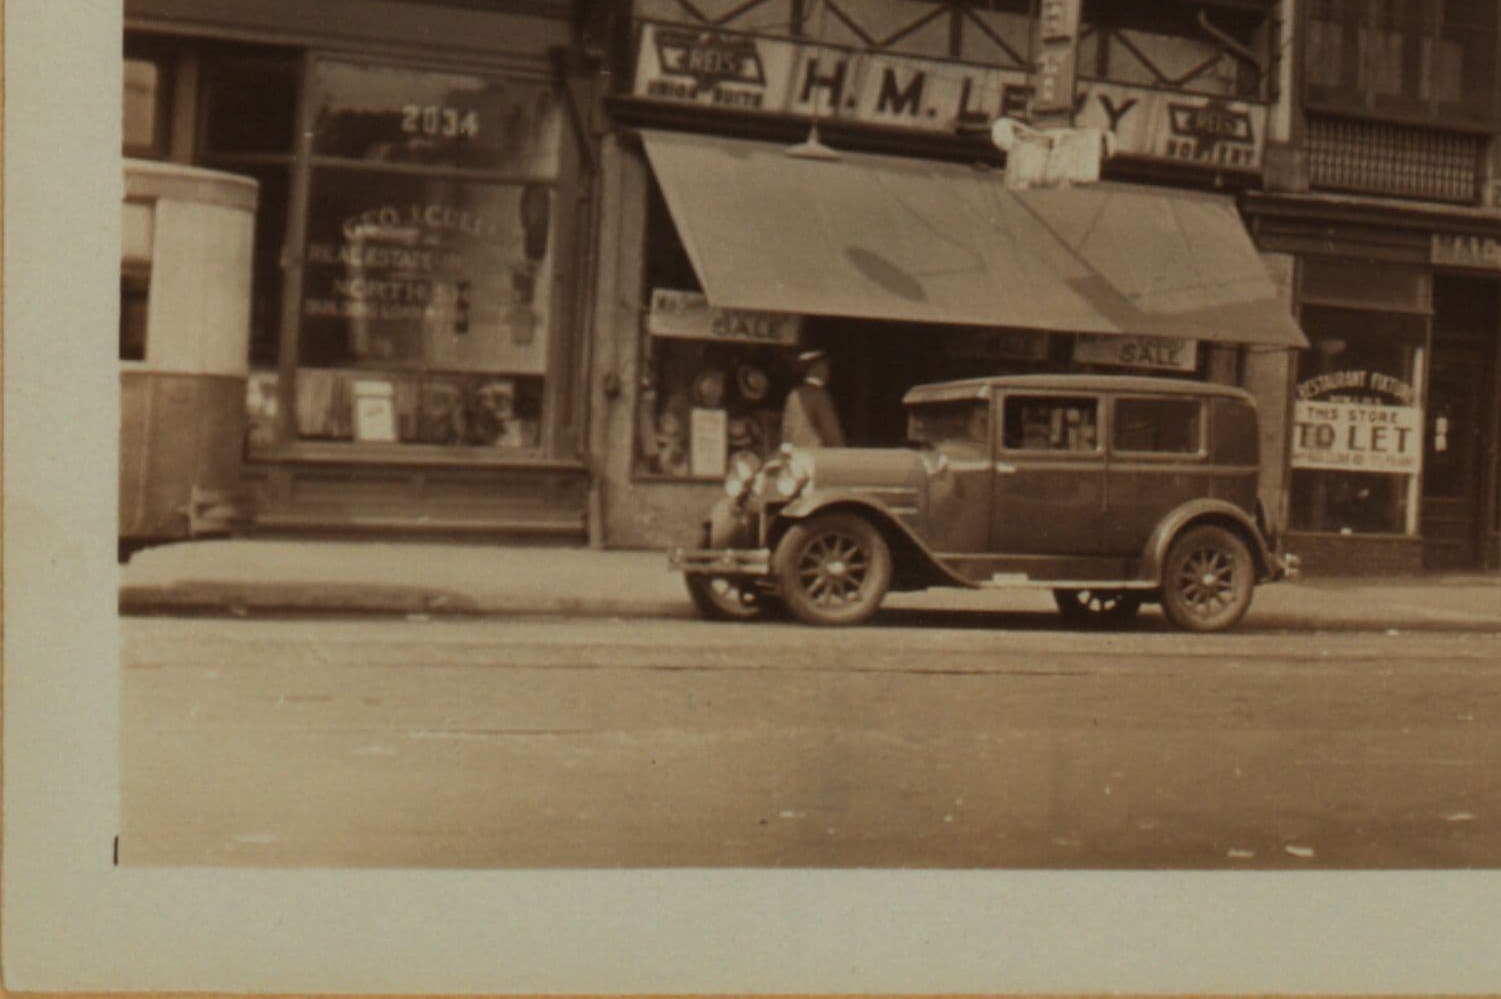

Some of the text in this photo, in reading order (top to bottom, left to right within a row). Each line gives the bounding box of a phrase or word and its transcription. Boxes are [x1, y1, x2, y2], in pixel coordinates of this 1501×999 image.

[400, 104, 480, 138] 2034
[1118, 342, 1181, 368] SALE
[1306, 406, 1398, 424] THIS STORE
[1298, 422, 1412, 453] TO LET
